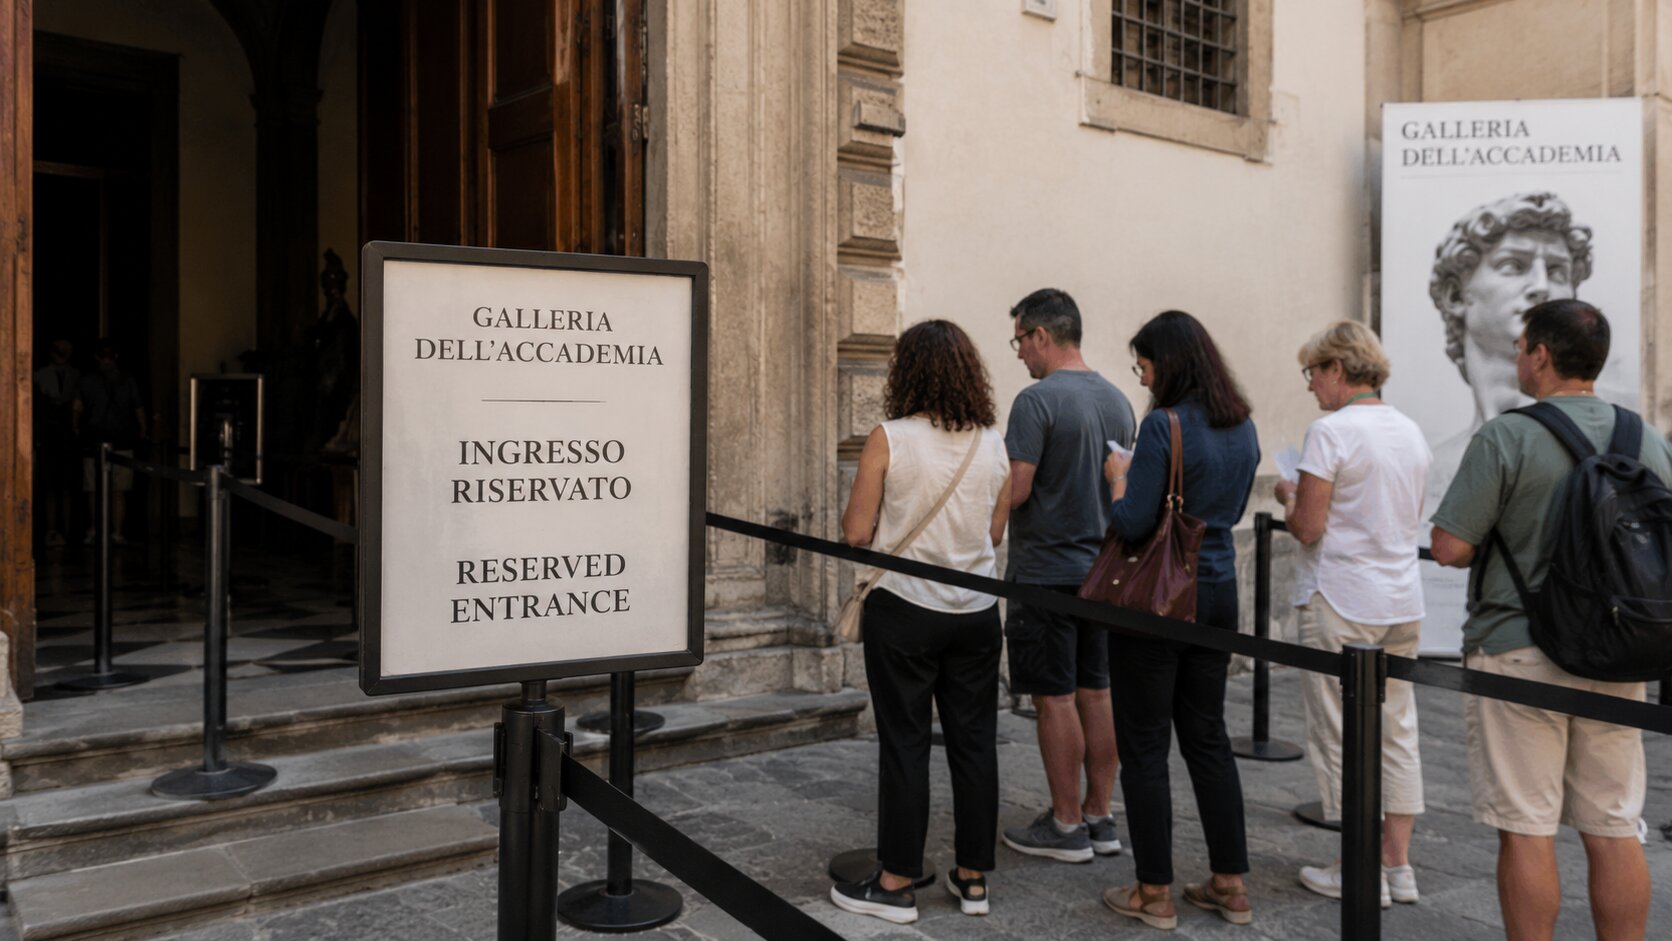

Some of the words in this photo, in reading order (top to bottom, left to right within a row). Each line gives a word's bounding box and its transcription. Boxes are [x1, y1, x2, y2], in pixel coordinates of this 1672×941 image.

[1401, 119, 1530, 140] GALLERIA
[1401, 145, 1622, 168] DELL’ACCADEMIA
[473, 306, 614, 333] GALLERIA
[415, 338, 664, 366] DELL’ACCADEMIA
[459, 439, 625, 466] INGRESSO
[451, 476, 632, 504] RISERVATO
[456, 553, 626, 585] RESERVED
[451, 588, 631, 624] ENTRANCE
